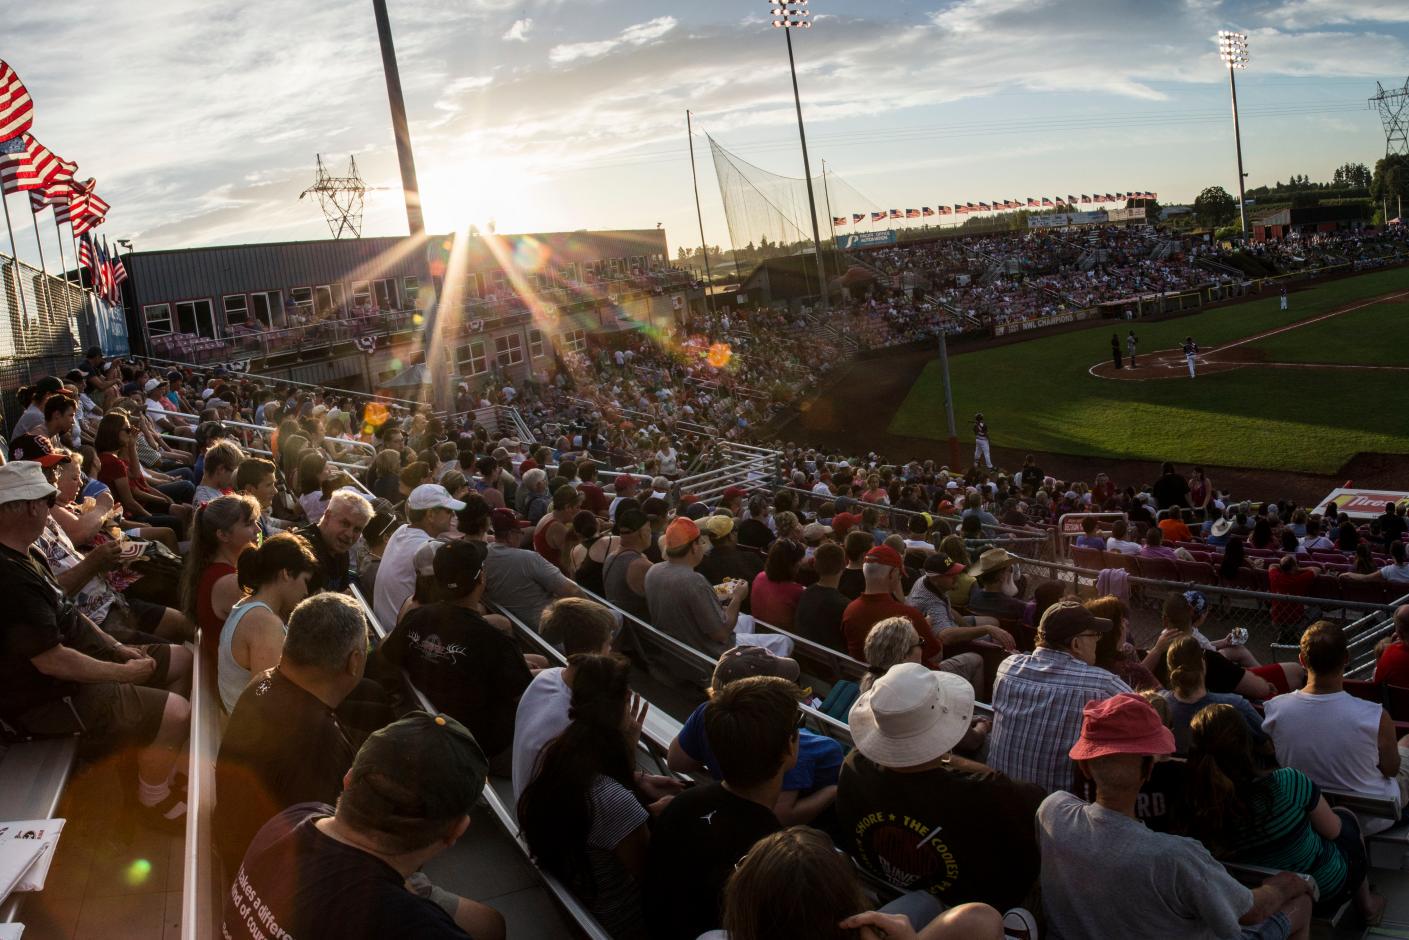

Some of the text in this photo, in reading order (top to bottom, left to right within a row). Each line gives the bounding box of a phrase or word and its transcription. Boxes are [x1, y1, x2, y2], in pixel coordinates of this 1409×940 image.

[855, 811, 885, 836] SHORE
[903, 815, 931, 837] THE
[239, 904, 252, 920] of
